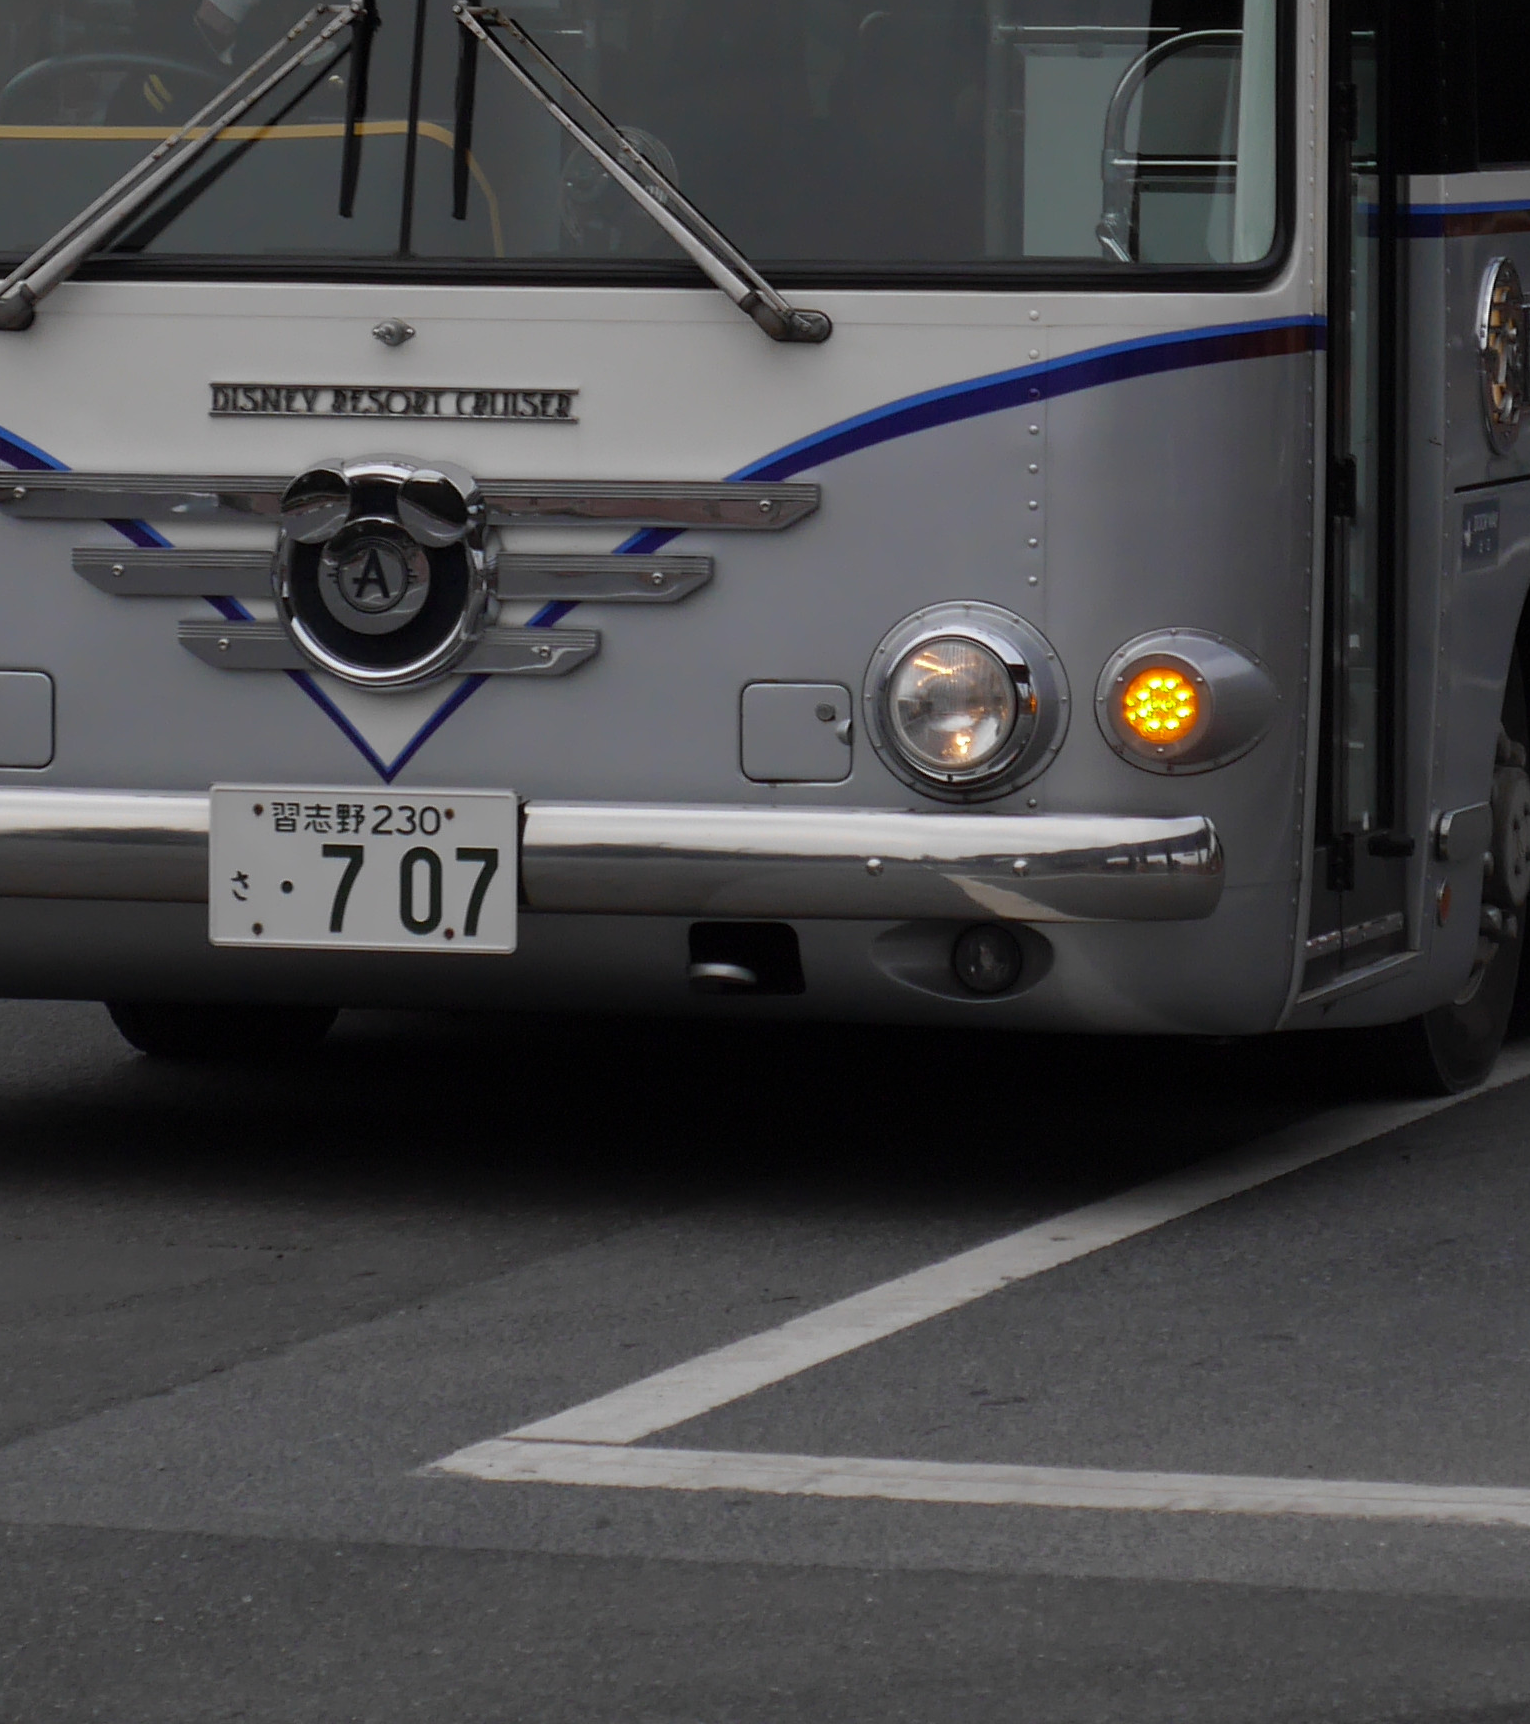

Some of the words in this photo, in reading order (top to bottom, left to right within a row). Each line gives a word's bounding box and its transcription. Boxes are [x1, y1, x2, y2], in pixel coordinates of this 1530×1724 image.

[211, 386, 320, 414] DISNEY
[331, 388, 442, 416] RESORT
[456, 390, 572, 419] CRUISER
[352, 547, 391, 599] A
[230, 870, 250, 902] さ
